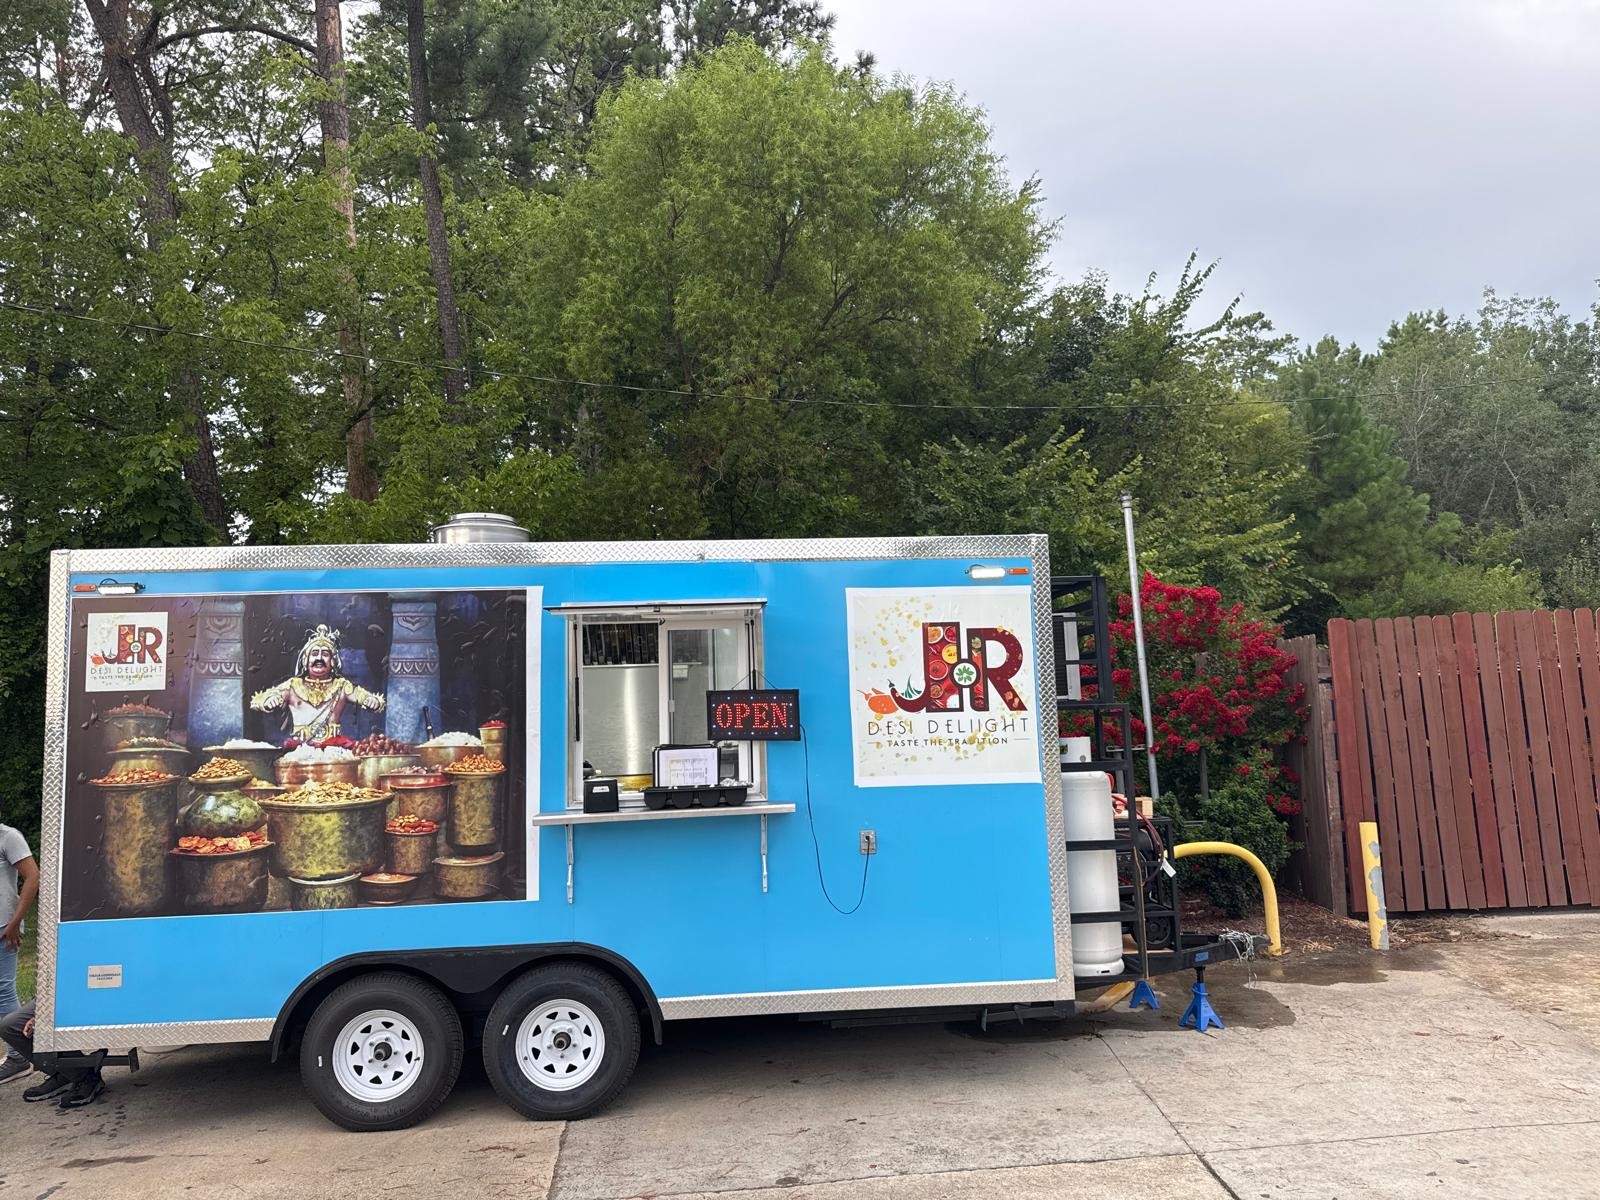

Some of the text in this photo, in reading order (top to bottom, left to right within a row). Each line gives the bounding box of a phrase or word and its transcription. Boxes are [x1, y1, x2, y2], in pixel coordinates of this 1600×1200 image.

[90, 667, 111, 675] DESI
[716, 703, 788, 728] OPEN
[868, 720, 913, 736] DESI
[887, 737, 1008, 747] TASTE THE TRAITION
